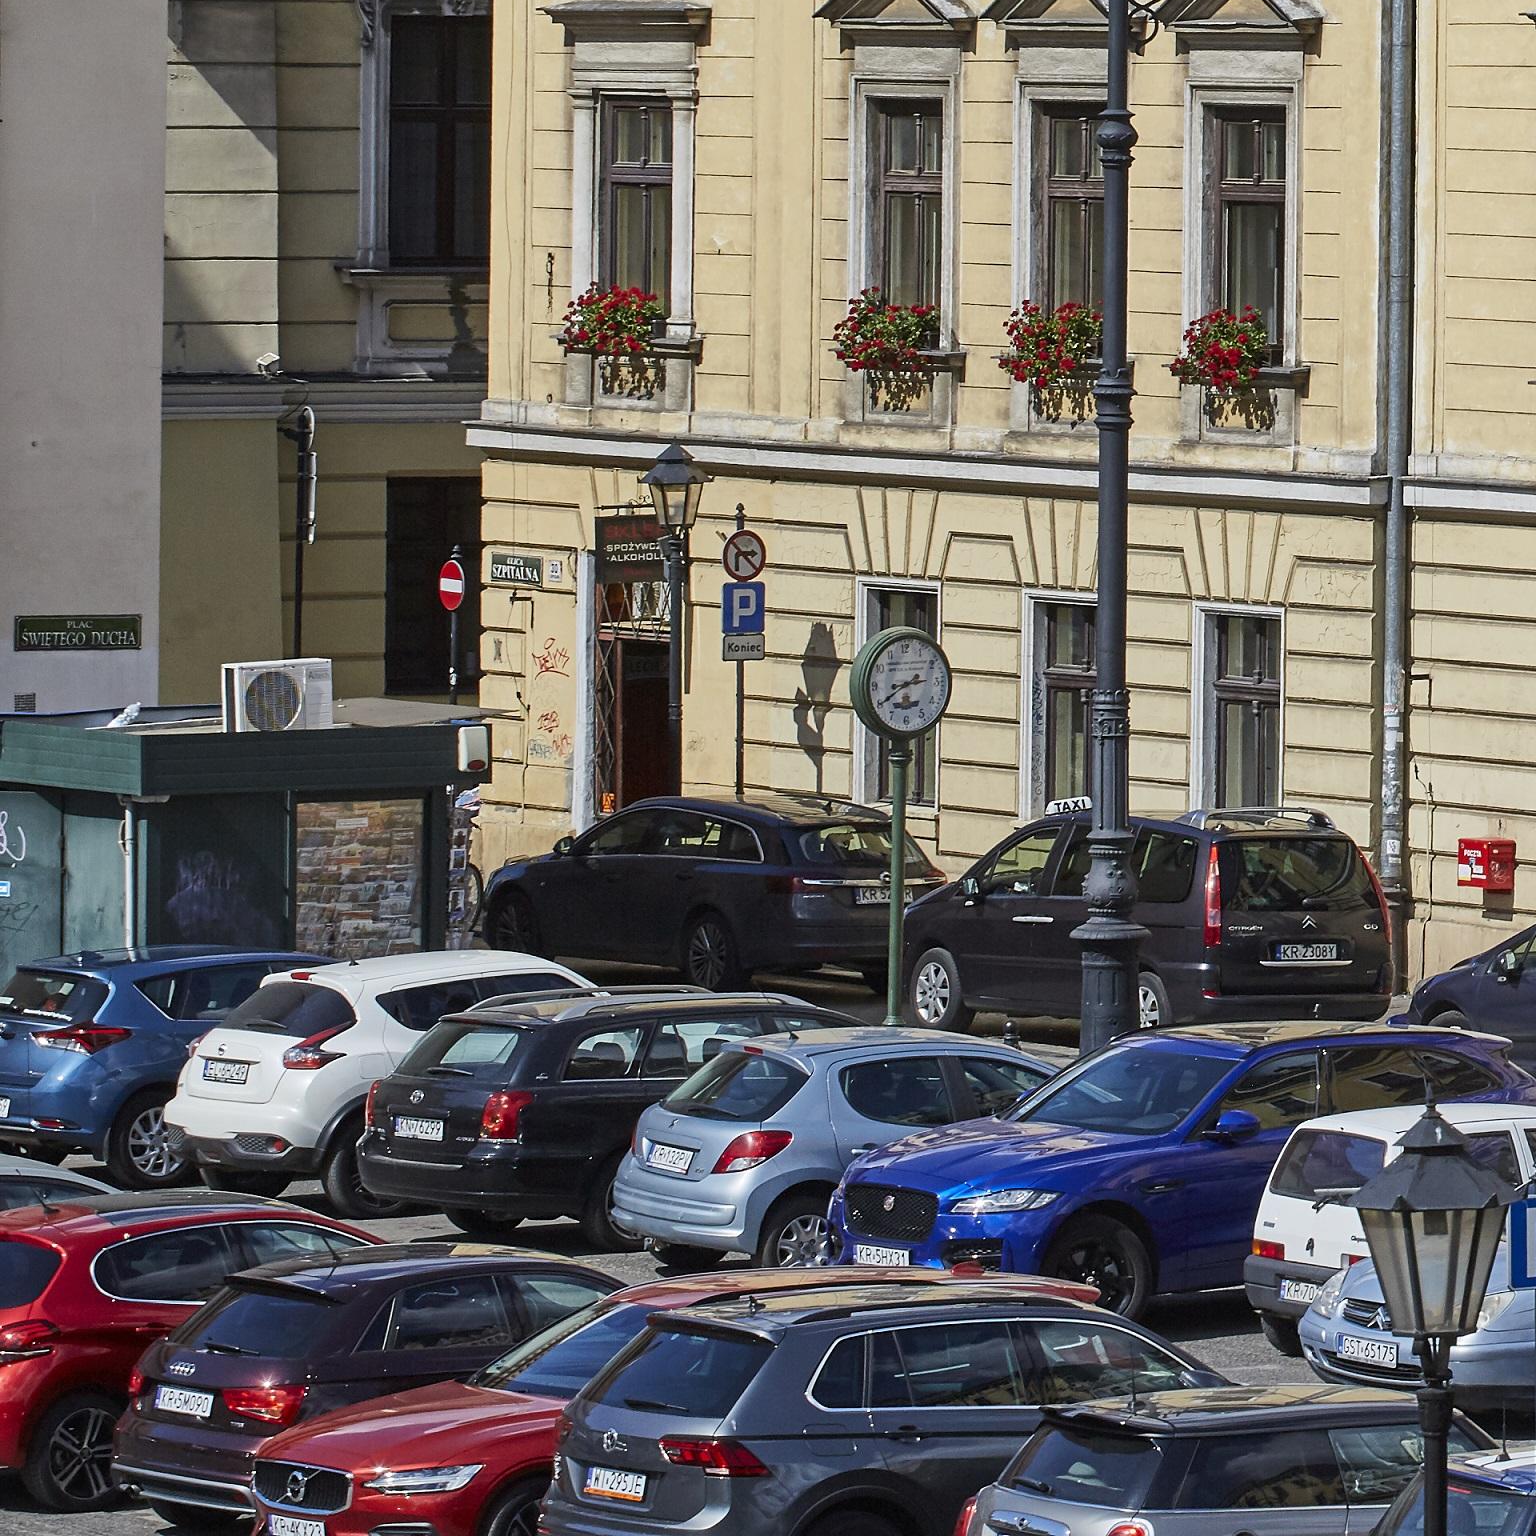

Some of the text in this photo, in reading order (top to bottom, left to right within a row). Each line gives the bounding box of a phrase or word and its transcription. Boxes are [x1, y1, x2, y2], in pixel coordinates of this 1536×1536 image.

[604, 542, 660, 551] -SPOŻYWCZ
[493, 564, 539, 581] SZPITALNA
[732, 589, 756, 627] P
[67, 621, 93, 629] PLAC
[91, 631, 136, 644] DUCHA
[728, 642, 761, 652] Koniec
[1054, 799, 1086, 812] TAXI
[1464, 848, 1482, 858] POCZTA
[861, 888, 878, 900] KR
[1282, 946, 1336, 958] KR 2308Y
[400, 1118, 441, 1136] KN 76299
[860, 1247, 904, 1265] KR 5HX31
[1286, 1282, 1319, 1301] KR 70
[1344, 1338, 1394, 1362] GST 65175
[162, 1388, 209, 1412] KR 5M090
[609, 1472, 642, 1494] 295JE
